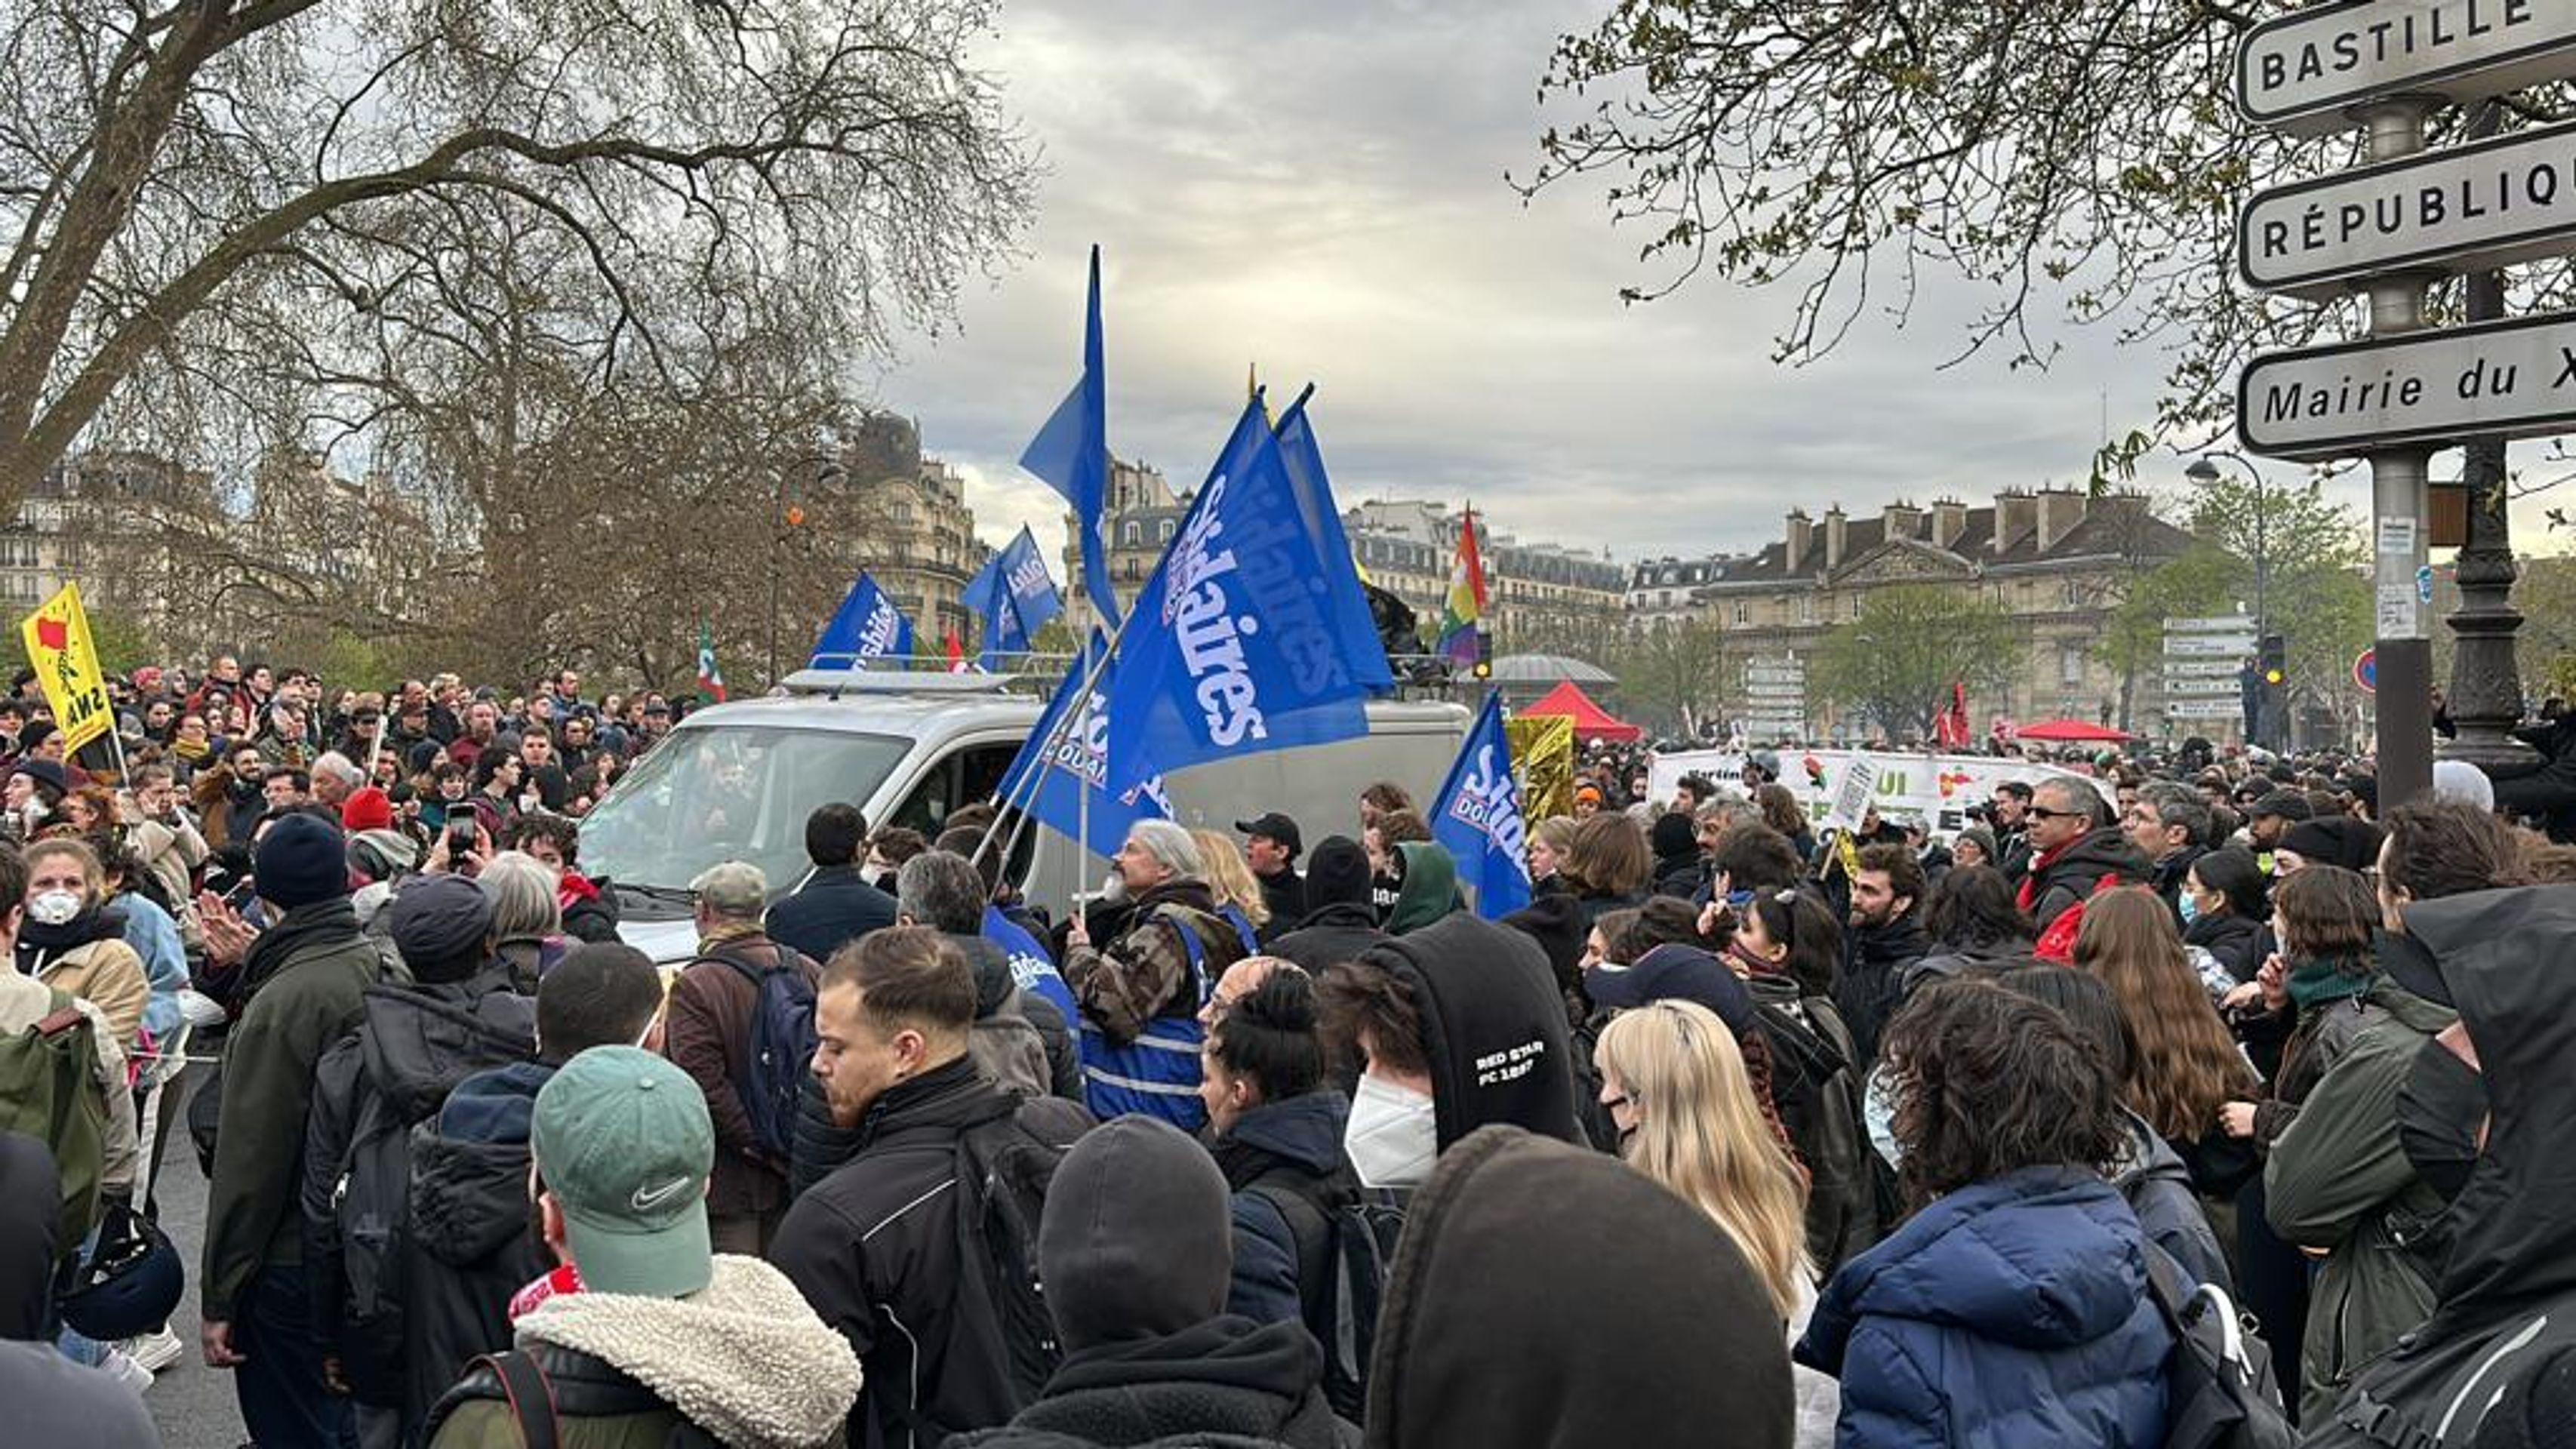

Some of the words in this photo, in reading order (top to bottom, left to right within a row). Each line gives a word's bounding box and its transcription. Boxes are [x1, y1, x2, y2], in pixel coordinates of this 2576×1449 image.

[2261, 0, 2531, 91] BASTILLE
[2263, 157, 2576, 257] RÉPUBLIQ
[2265, 370, 2422, 423] Mairie
[2458, 358, 2517, 398] du
[1477, 1052, 1507, 1070] RED
[1510, 1041, 1544, 1062] STAR
